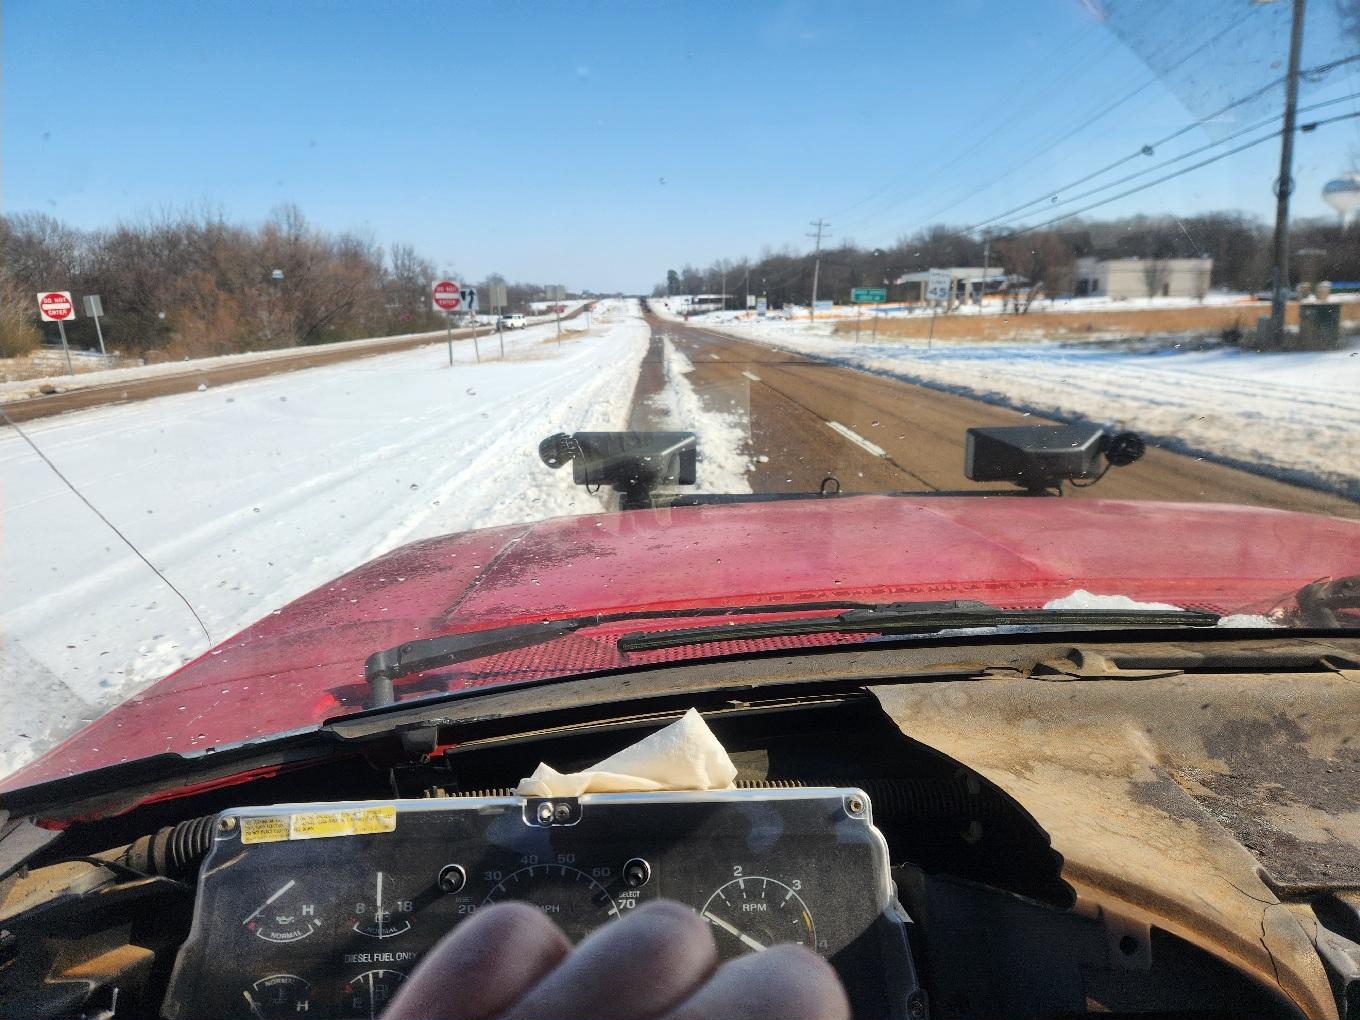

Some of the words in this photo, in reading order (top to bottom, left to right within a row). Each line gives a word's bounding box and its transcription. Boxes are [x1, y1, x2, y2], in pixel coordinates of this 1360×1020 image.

[520, 855, 538, 865] 40
[557, 854, 576, 864] 50
[484, 871, 502, 881] 30
[592, 867, 610, 877] 60
[733, 866, 742, 876] 2
[792, 880, 802, 890] 3
[356, 902, 366, 914] 8
[396, 900, 414, 912] 18
[458, 904, 476, 914] 20
[618, 900, 636, 909] 70
[742, 903, 767, 912] RPM
[302, 904, 314, 916] H
[270, 930, 303, 940] NORMAL
[818, 940, 828, 949] 4
[344, 953, 372, 963] DIESEL
[374, 952, 394, 962] FUEL
[396, 952, 418, 961] ONLY
[296, 1000, 308, 1012] H
